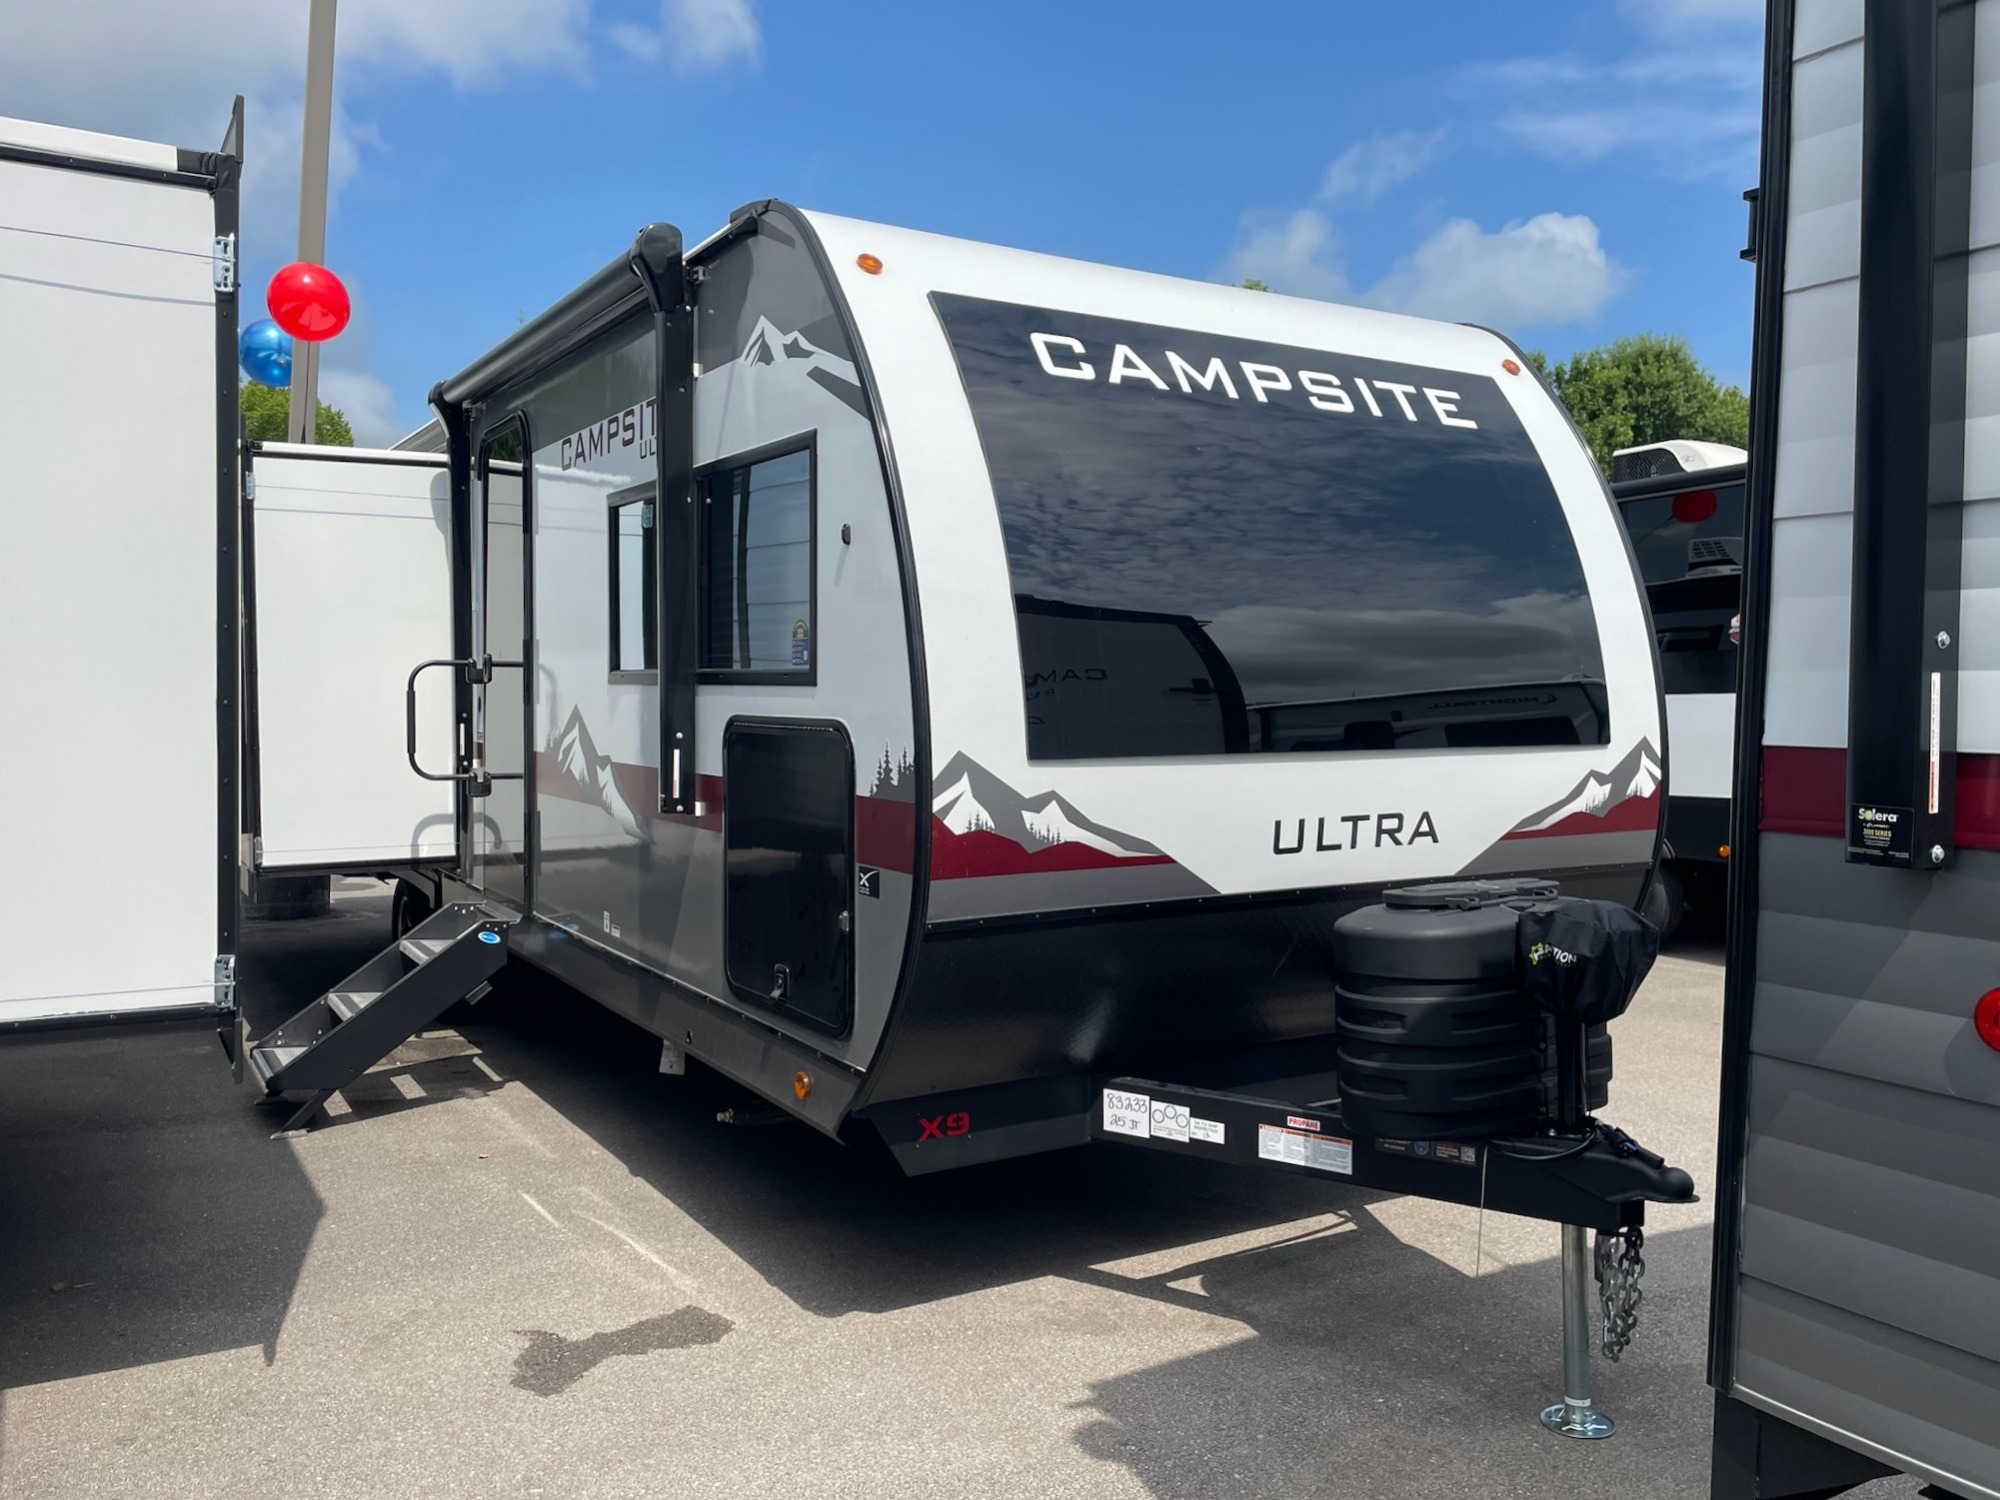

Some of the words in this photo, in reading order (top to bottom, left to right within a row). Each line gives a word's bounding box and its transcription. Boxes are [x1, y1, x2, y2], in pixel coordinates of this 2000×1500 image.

[1029, 331, 1479, 430] CAMPSITE
[561, 398, 657, 471] CAMPSIT
[1858, 808, 1898, 822] Solera
[1273, 811, 1439, 855] ULTRA
[1106, 1093, 1148, 1114] 83233
[918, 1112, 970, 1141] X9
[1110, 1113, 1127, 1127] 25
[1288, 1117, 1319, 1130] PROPANE
